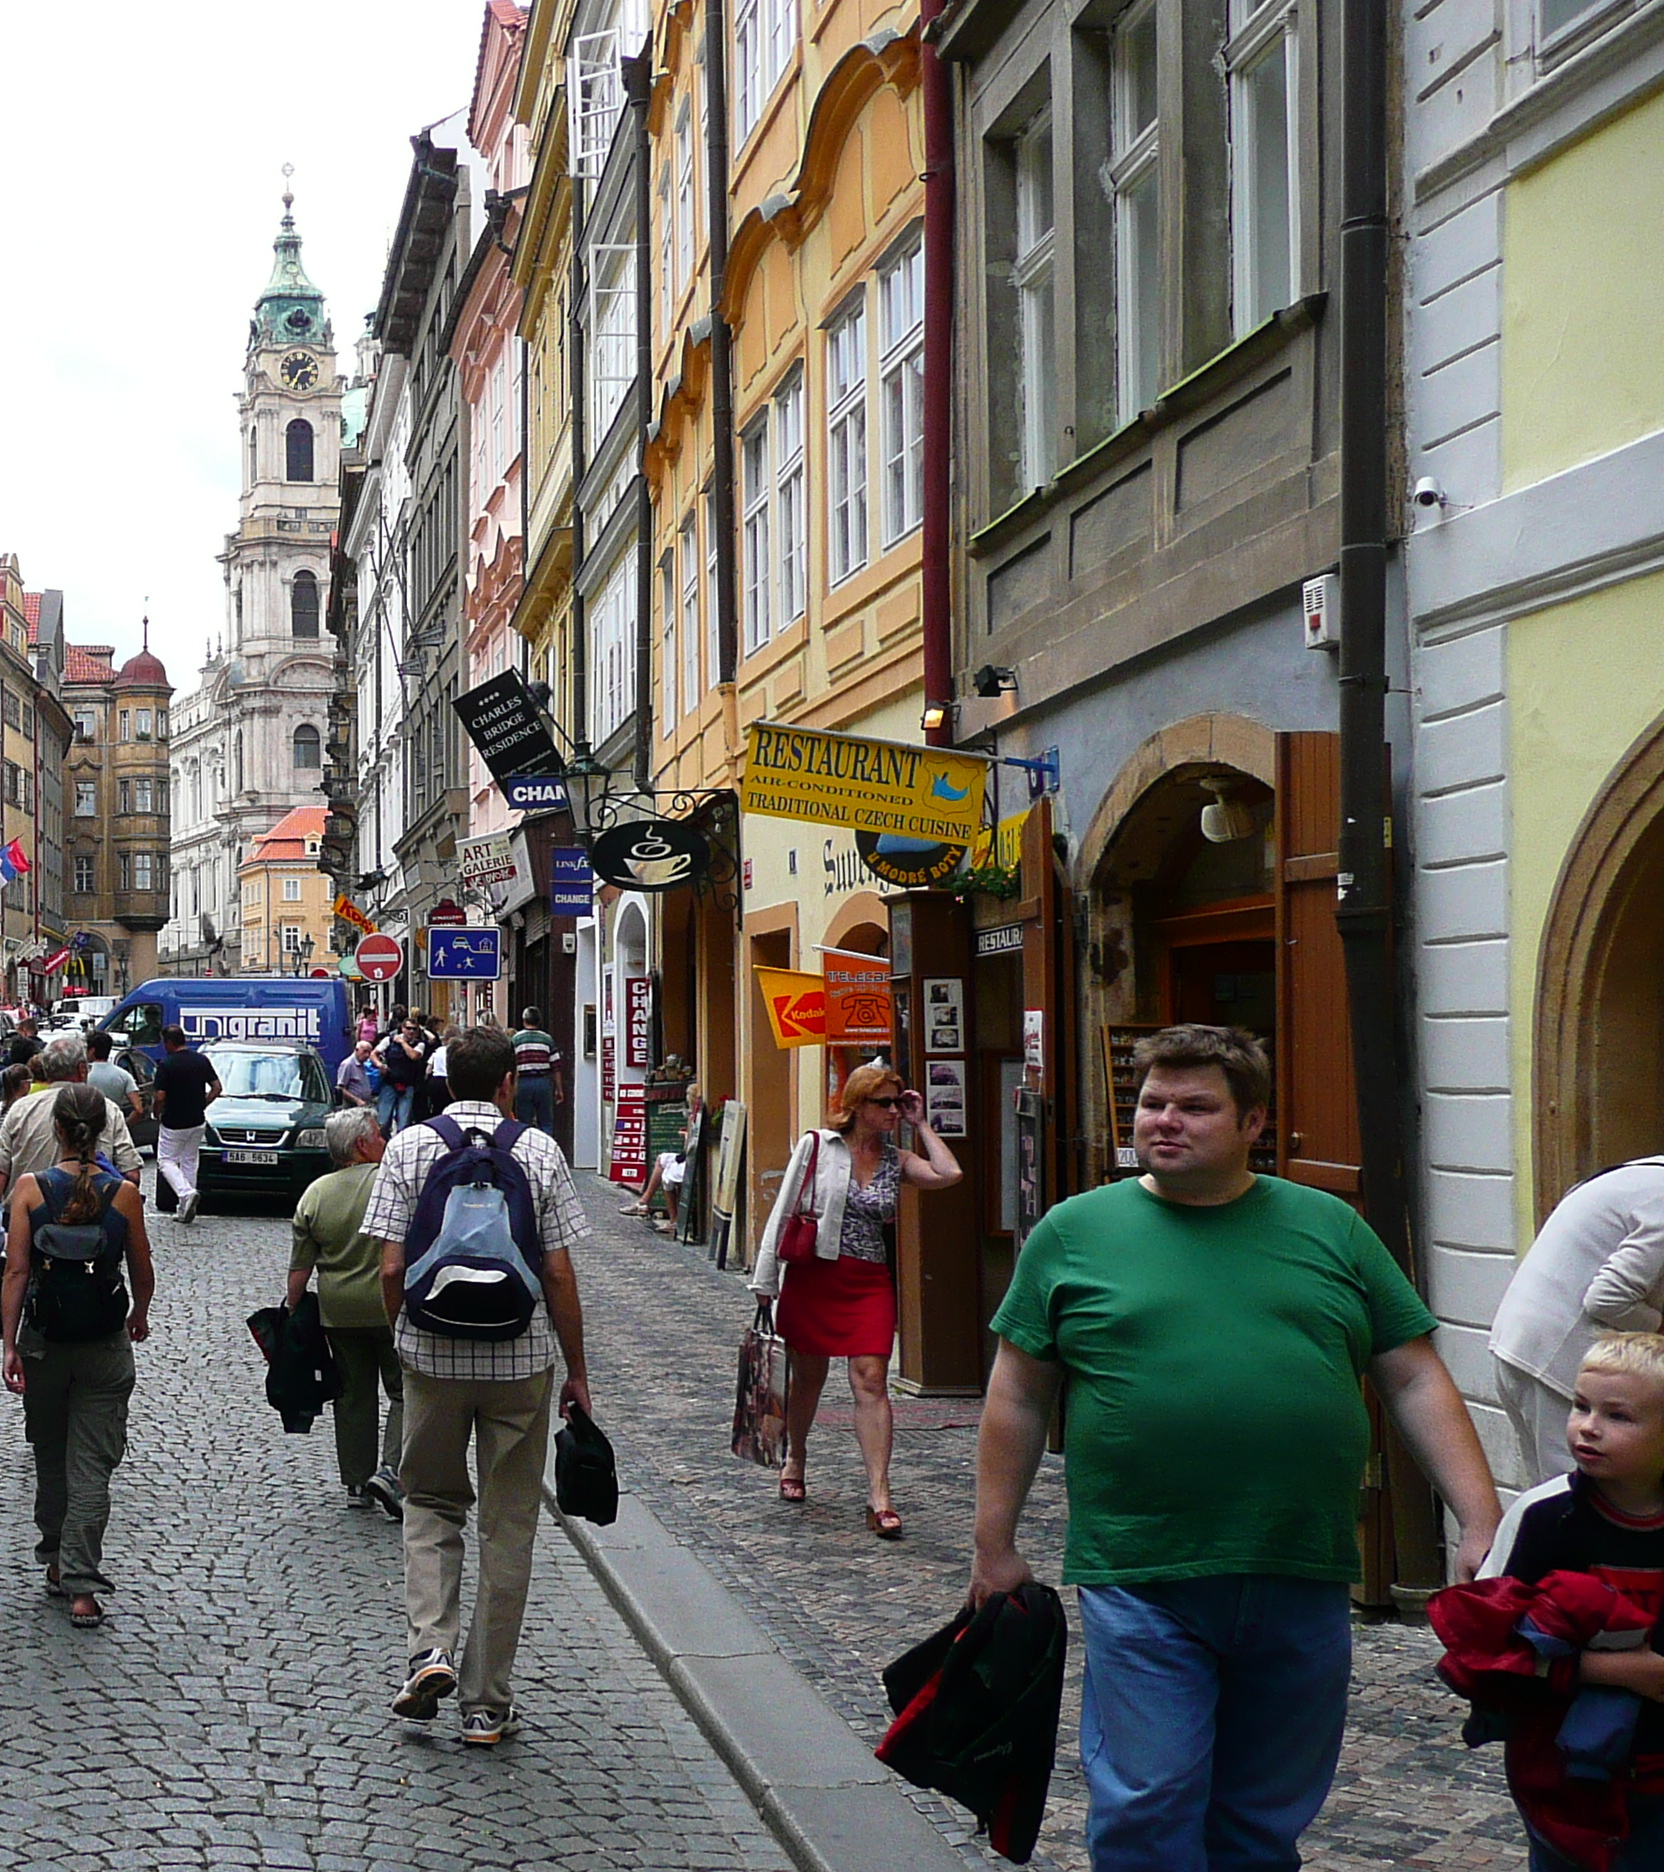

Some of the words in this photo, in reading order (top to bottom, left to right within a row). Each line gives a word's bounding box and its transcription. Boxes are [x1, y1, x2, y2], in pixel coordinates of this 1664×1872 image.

[471, 695, 523, 729] CHARLES
[483, 711, 526, 741] BRIDGE
[481, 720, 543, 760] RESIDENCE
[752, 729, 923, 789] RESTAURANT
[512, 785, 567, 802] CHAN
[750, 774, 914, 806] AIR-CONDITIONED
[747, 792, 851, 822] TRADITIONAL
[854, 808, 906, 830] CZECH
[908, 815, 973, 840] CUISINE
[463, 842, 492, 863] ART
[464, 854, 513, 875] GALERIE
[867, 851, 881, 864] U
[877, 861, 928, 884] MODRÉ
[930, 845, 962, 879] BOTY
[555, 894, 590, 904] CHANGE
[978, 927, 1023, 952] RESTAUR
[632, 981, 648, 1064] CHANGE
[791, 1007, 825, 1020] Kodak
